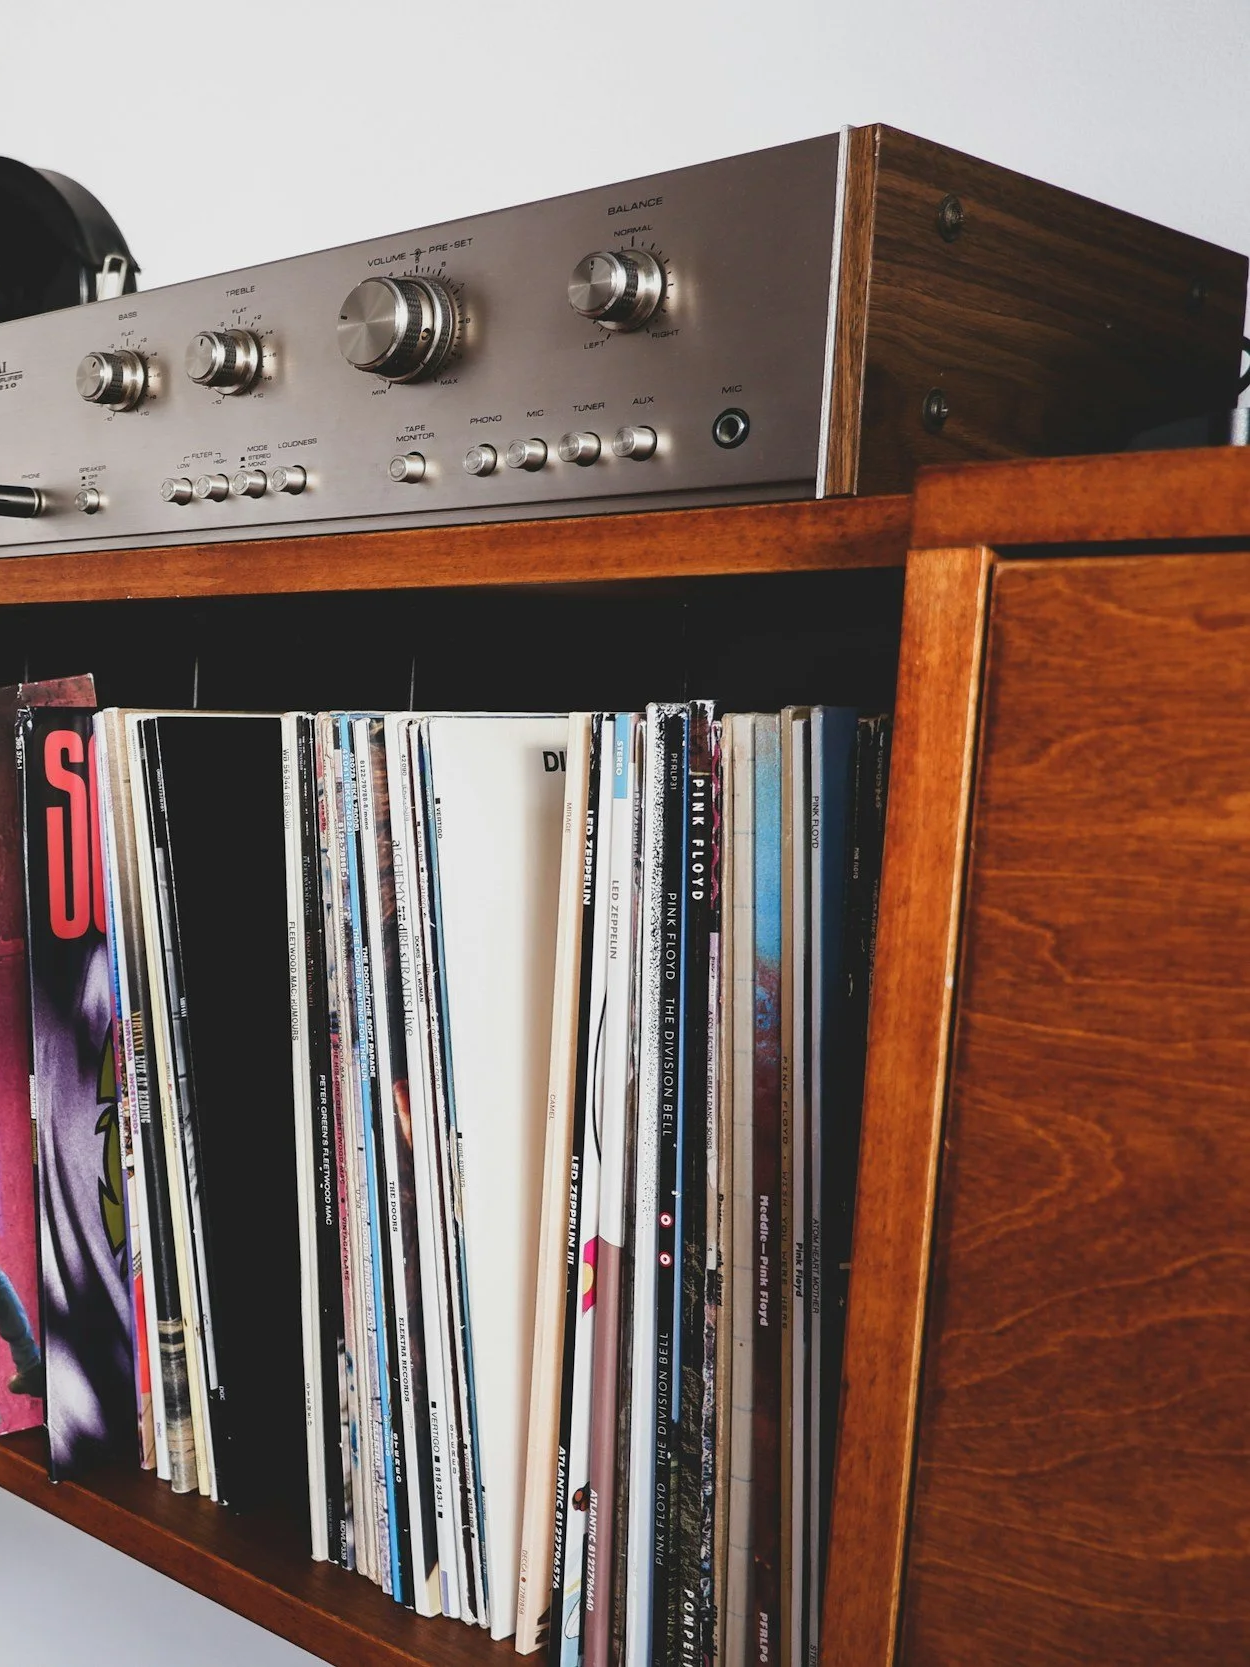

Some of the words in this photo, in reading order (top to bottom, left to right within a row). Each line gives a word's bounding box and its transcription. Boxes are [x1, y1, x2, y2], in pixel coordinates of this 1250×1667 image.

[607, 197, 664, 216] BALANCE
[613, 224, 653, 238] NORMAL
[367, 253, 407, 267] VOLUME
[428, 238, 474, 254] PRE-SET
[225, 285, 256, 298] TREBLE
[118, 311, 138, 321] BASS
[231, 306, 248, 315] FLAT
[583, 340, 606, 350] LEFT
[651, 328, 681, 340] RIGHT
[440, 378, 459, 386] MAX
[721, 384, 743, 395] MIC
[526, 409, 545, 418] MIC
[572, 401, 605, 413] TUNER
[632, 395, 655, 406] AUX
[404, 424, 426, 433] TAPE
[469, 414, 503, 425] PHONO
[246, 444, 269, 453] MODE
[277, 437, 318, 450] LOUDNESS
[395, 432, 436, 443] MONITOR
[191, 451, 214, 460] FILTER
[615, 740, 624, 776] STEREO
[669, 753, 679, 791] PFRLP31
[691, 778, 705, 827] PINK
[811, 795, 820, 817] PINK
[564, 802, 573, 834] MIRAGE
[585, 809, 595, 836] LED
[810, 818, 820, 850] FLOYD
[582, 840, 594, 905] ZEPPELIN
[691, 838, 705, 902] FLOYD
[611, 880, 620, 901] LED
[665, 892, 677, 926] PINK
[352, 927, 360, 945] THE
[609, 904, 619, 960] ZEPPELIN
[288, 920, 297, 975] FLEETWOOD
[362, 946, 370, 964] THE
[414, 935, 422, 959] DOORS
[664, 933, 677, 981] FLOYD
[290, 976, 298, 998] MAC:
[417, 978, 425, 1003] WOMAN
[290, 999, 299, 1042] RUMOURS
[664, 998, 676, 1025] THE
[124, 1019, 134, 1062] NIRVANA
[131, 1011, 145, 1051] NIRVANA
[358, 1024, 366, 1042] FOR
[366, 1017, 375, 1041] SOFT
[135, 1055, 147, 1074] LIVE
[361, 1062, 369, 1081] SUN
[367, 1042, 377, 1078] PARADE
[662, 1031, 675, 1098] DIVISION
[136, 1077, 148, 1088] AT
[319, 1074, 327, 1104] PETER
[138, 1090, 151, 1124] READING
[548, 1093, 556, 1121] CAMEL
[661, 1104, 673, 1137] BELL
[321, 1106, 330, 1146] GREEN'S
[323, 1147, 332, 1203] FLEETWOOD
[570, 1155, 580, 1181] LED
[325, 1204, 333, 1226] MAC
[390, 1201, 398, 1232] DOORS
[567, 1184, 578, 1248] ZEPPELIN
[781, 1216, 789, 1243] YOU
[812, 1218, 820, 1244] ATOM
[566, 1251, 575, 1266] III
[781, 1250, 789, 1286] WERE
[795, 1242, 804, 1267] Pink
[812, 1245, 820, 1274] HEART
[793, 1269, 804, 1298] Floyd
[812, 1276, 820, 1315] MOTHER
[758, 1290, 769, 1327] Floyd
[399, 1317, 407, 1357] ELEKTRA
[658, 1332, 669, 1365] BELL
[219, 1386, 227, 1401] DGC
[402, 1359, 410, 1402] RECORDS
[656, 1370, 669, 1435] DIVISION
[431, 1411, 441, 1453] VERTIGO
[393, 1432, 402, 1483] STEREO
[656, 1441, 667, 1467] THE
[434, 1466, 442, 1482] 818
[556, 1445, 567, 1510] ATLANTIC
[435, 1484, 444, 1508] 243-1
[654, 1482, 667, 1528] FLOYD
[588, 1488, 598, 1543] ATLANTIC
[339, 1519, 348, 1561] MOVLP339
[552, 1510, 564, 1589] 8122796576
[654, 1533, 666, 1566] PINK
[521, 1549, 530, 1573] DECCA
[585, 1544, 597, 1611] 8122796640
[759, 1611, 769, 1663] PFRLP6
